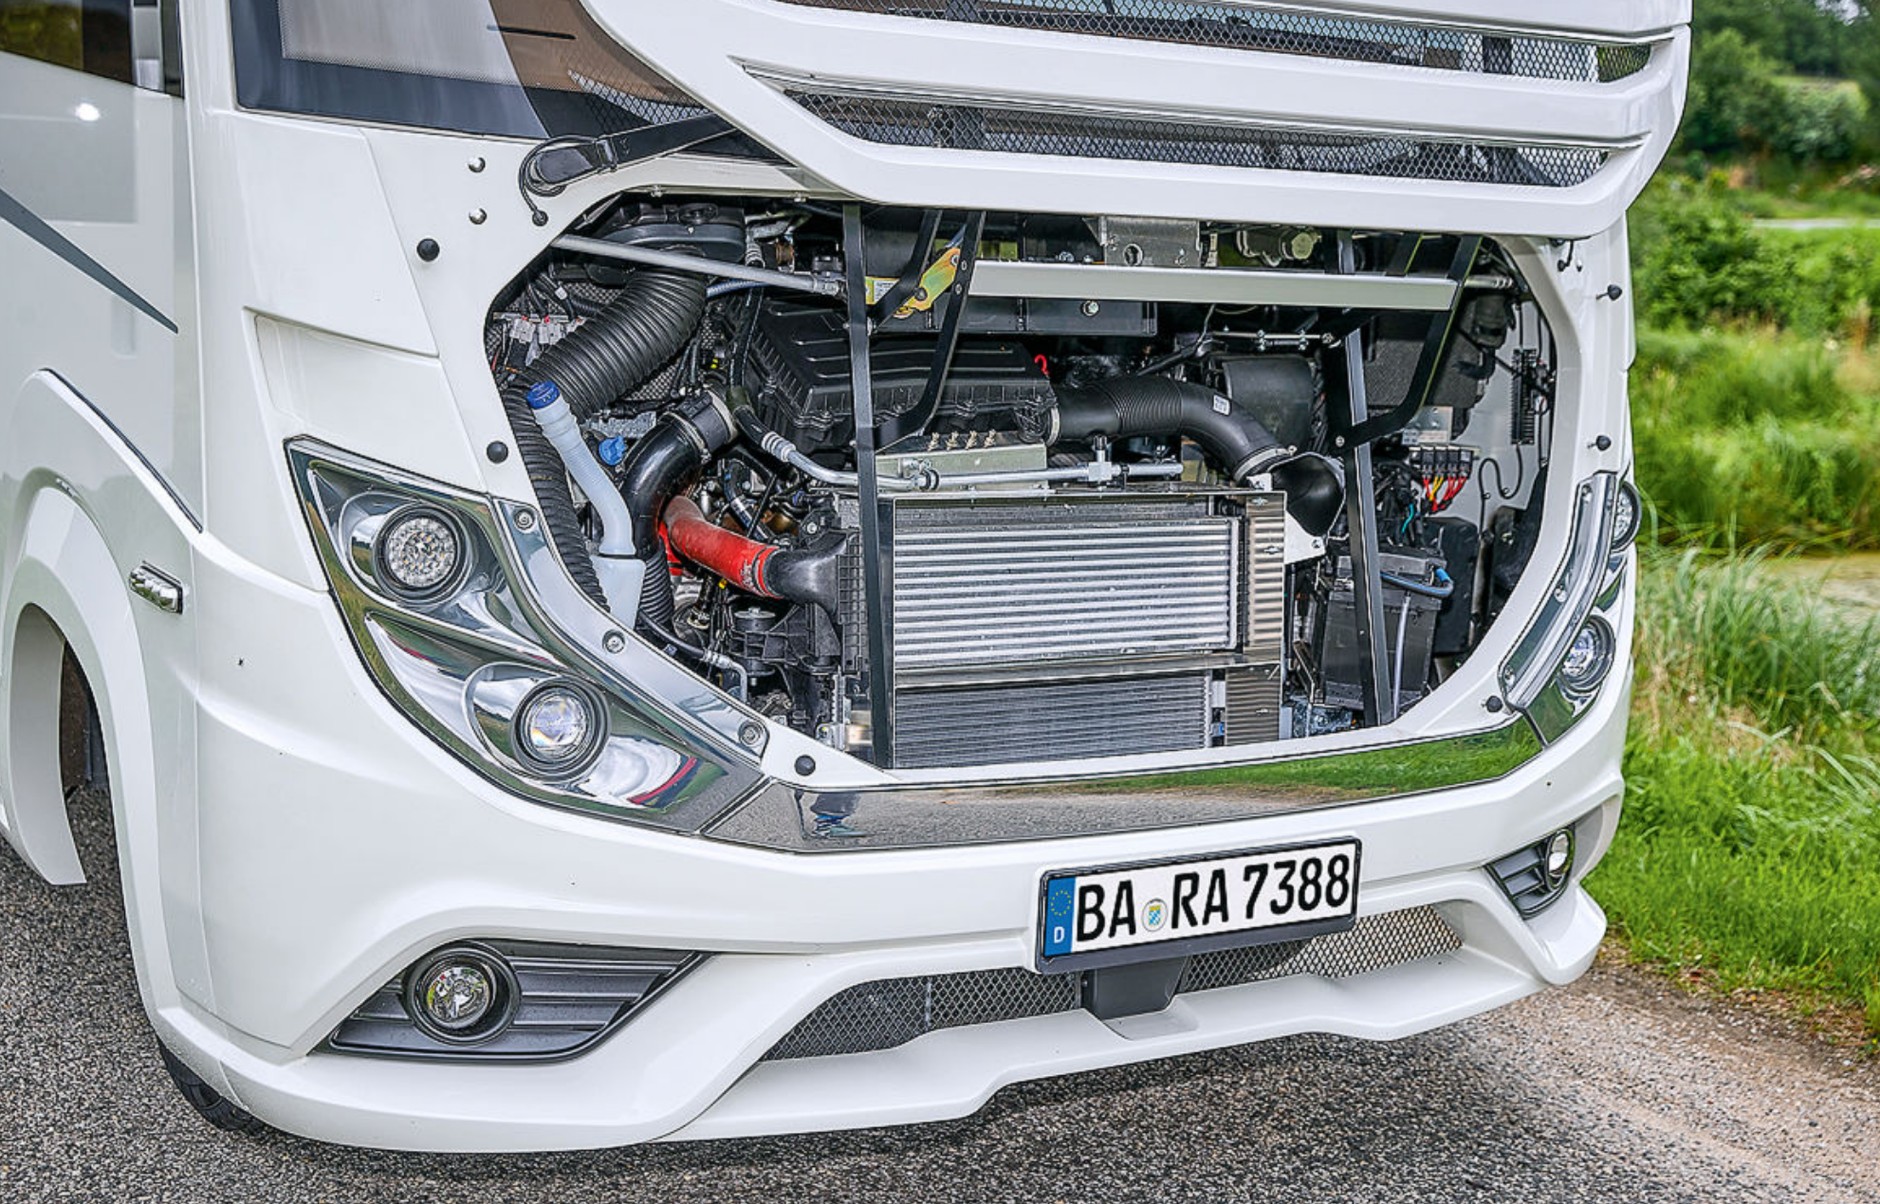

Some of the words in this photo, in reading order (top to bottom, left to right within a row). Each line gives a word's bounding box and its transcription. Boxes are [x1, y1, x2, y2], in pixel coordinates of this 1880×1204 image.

[1076, 879, 1137, 942] BA
[1171, 868, 1229, 929] RA
[1243, 853, 1350, 919] 7388
[1053, 926, 1066, 944] D
